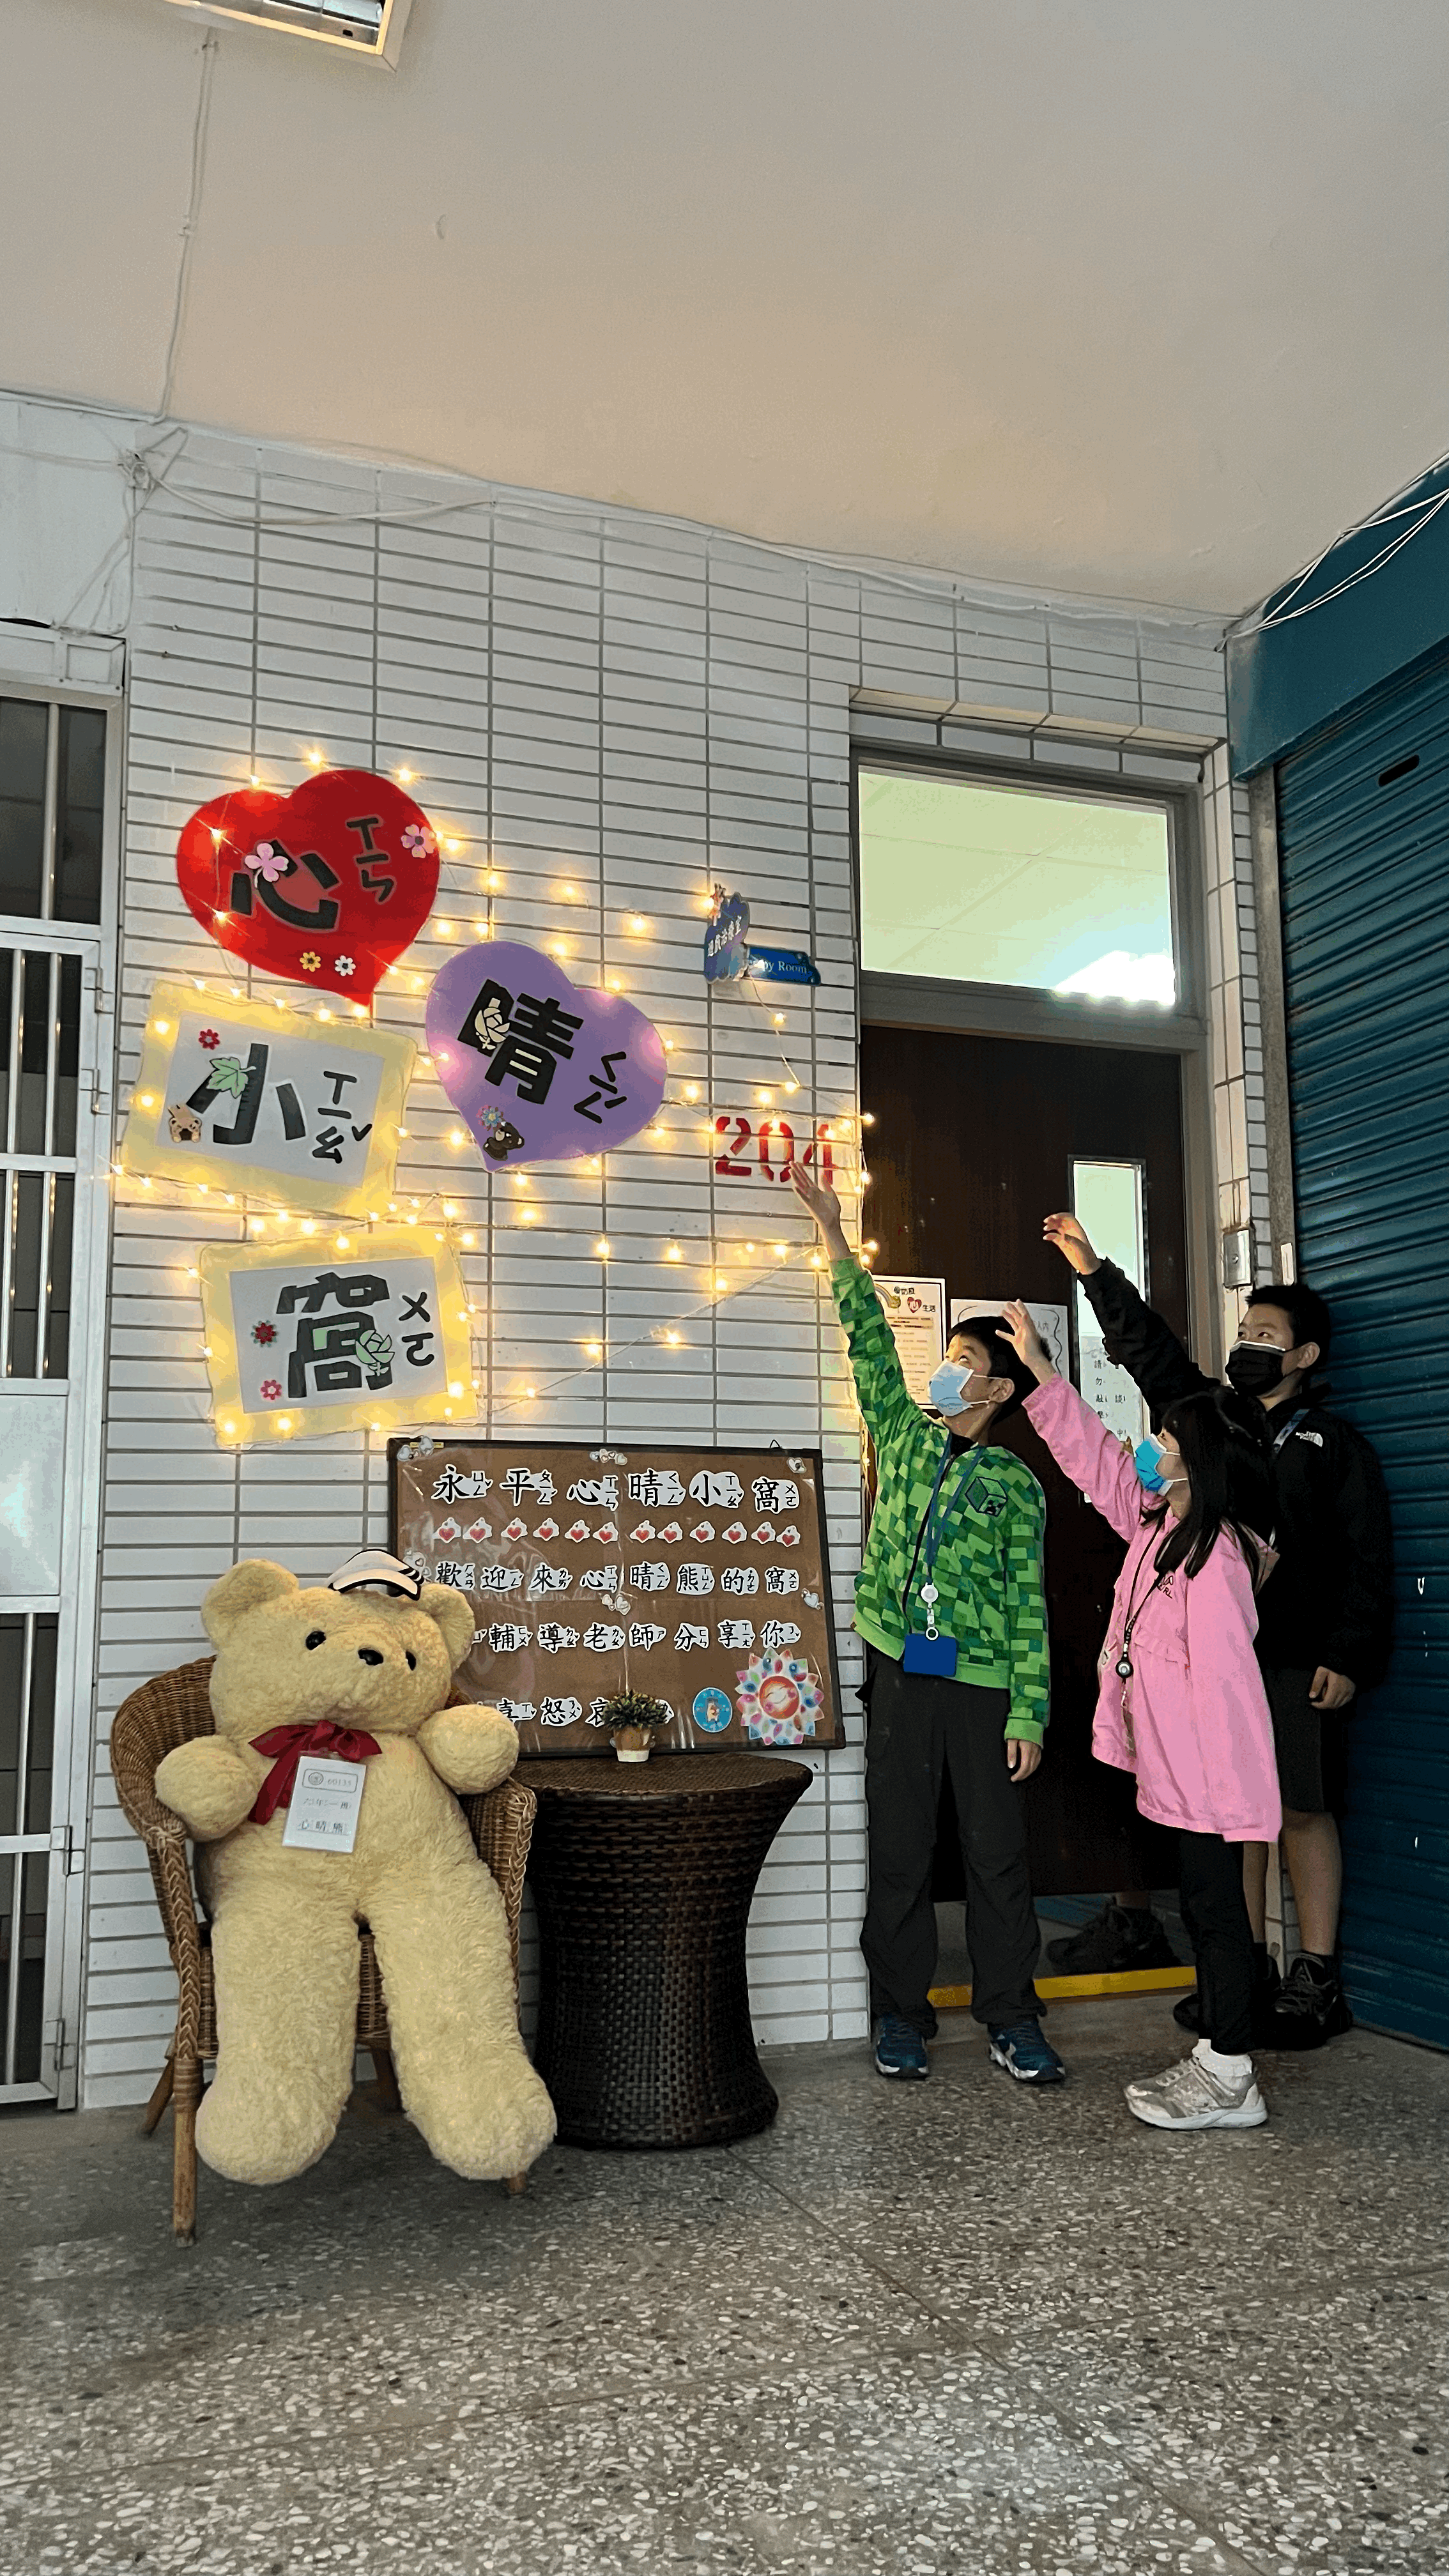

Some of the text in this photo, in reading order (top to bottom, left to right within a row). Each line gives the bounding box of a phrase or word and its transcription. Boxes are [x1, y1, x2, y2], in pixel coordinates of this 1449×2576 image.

[231, 839, 339, 930] 心
[778, 961, 807, 974] Room
[457, 979, 584, 1104] 晴
[186, 1043, 306, 1144] 小
[716, 1116, 839, 1185] 204
[276, 1272, 393, 1398] 窩
